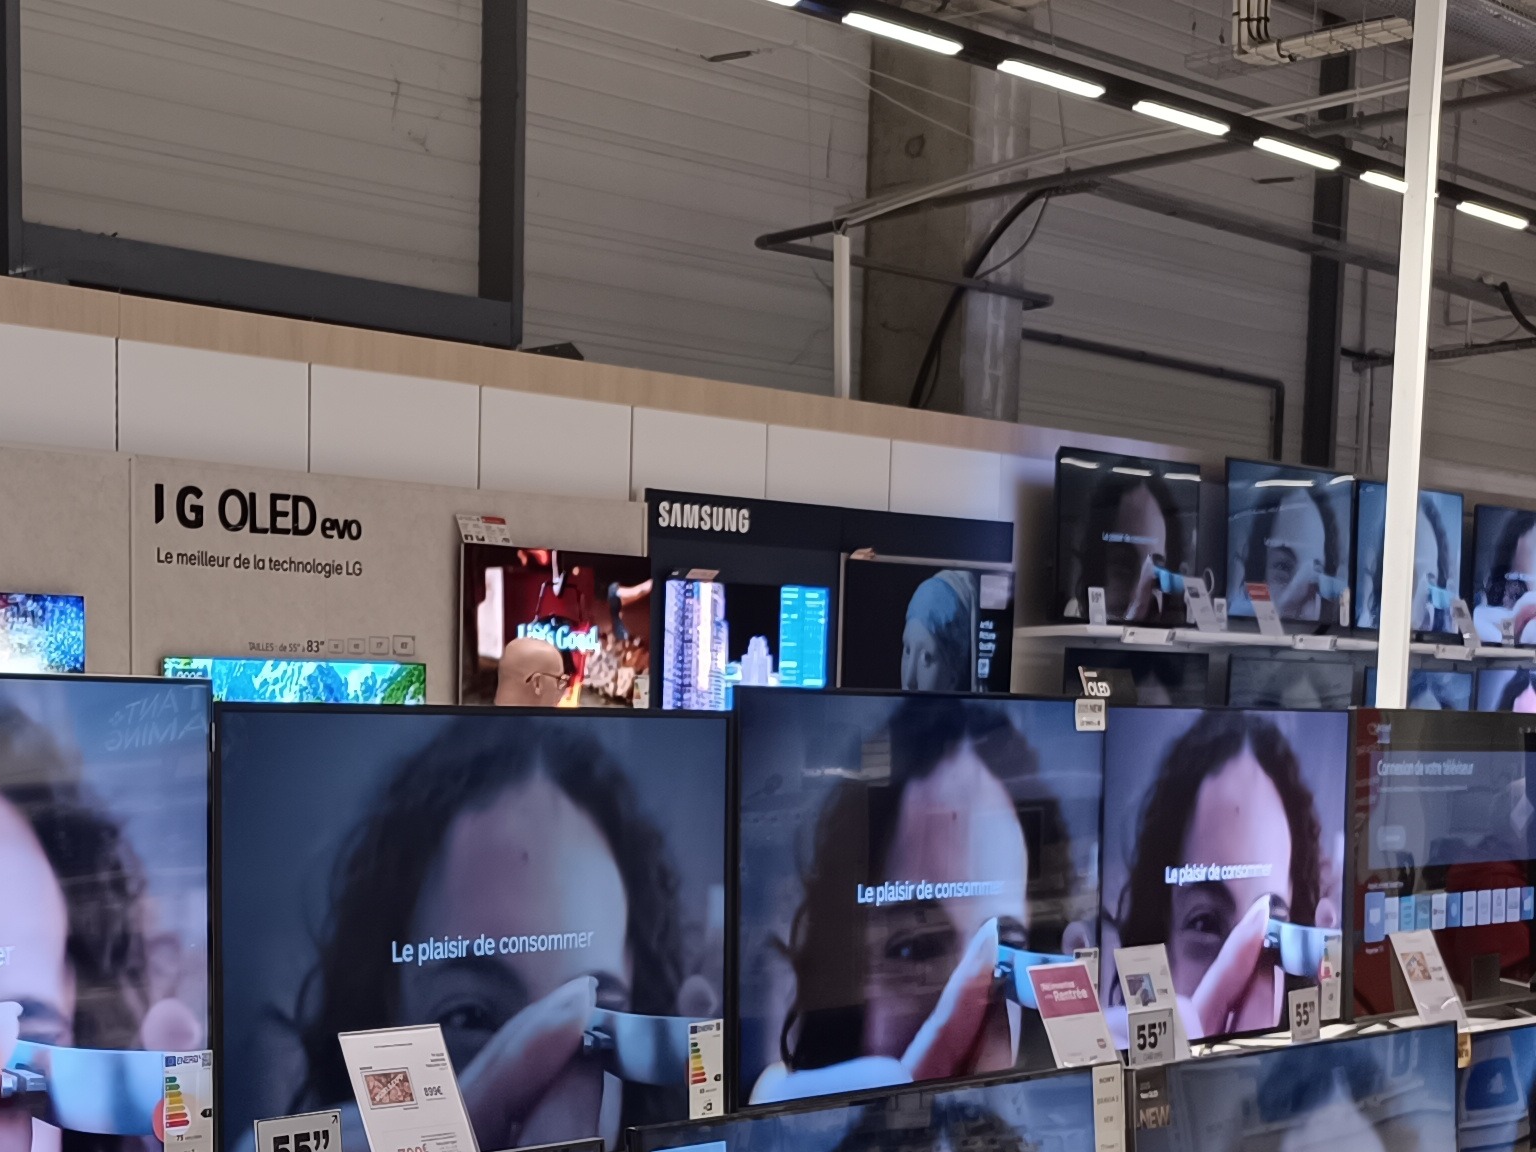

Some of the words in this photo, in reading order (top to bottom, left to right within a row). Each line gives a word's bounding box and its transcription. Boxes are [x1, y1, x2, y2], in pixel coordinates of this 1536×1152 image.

[218, 488, 317, 536] OLED
[320, 517, 362, 541] evo
[659, 501, 750, 533] SAMSUNG
[156, 547, 173, 564] Le
[176, 550, 230, 568] meilleur
[233, 553, 250, 569] de
[253, 554, 265, 571] la
[268, 557, 343, 578] technologie
[345, 561, 363, 576] LG
[1088, 682, 1110, 696] OLED
[1165, 866, 1178, 884] Le
[1179, 863, 1207, 886] plaisir
[1208, 863, 1221, 881] de
[857, 883, 874, 903] Le
[876, 880, 914, 906] plaisir
[916, 879, 933, 900] de
[392, 940, 413, 963] Le
[418, 935, 469, 966] plaisir
[473, 934, 495, 956] de
[499, 931, 594, 953] consommer
